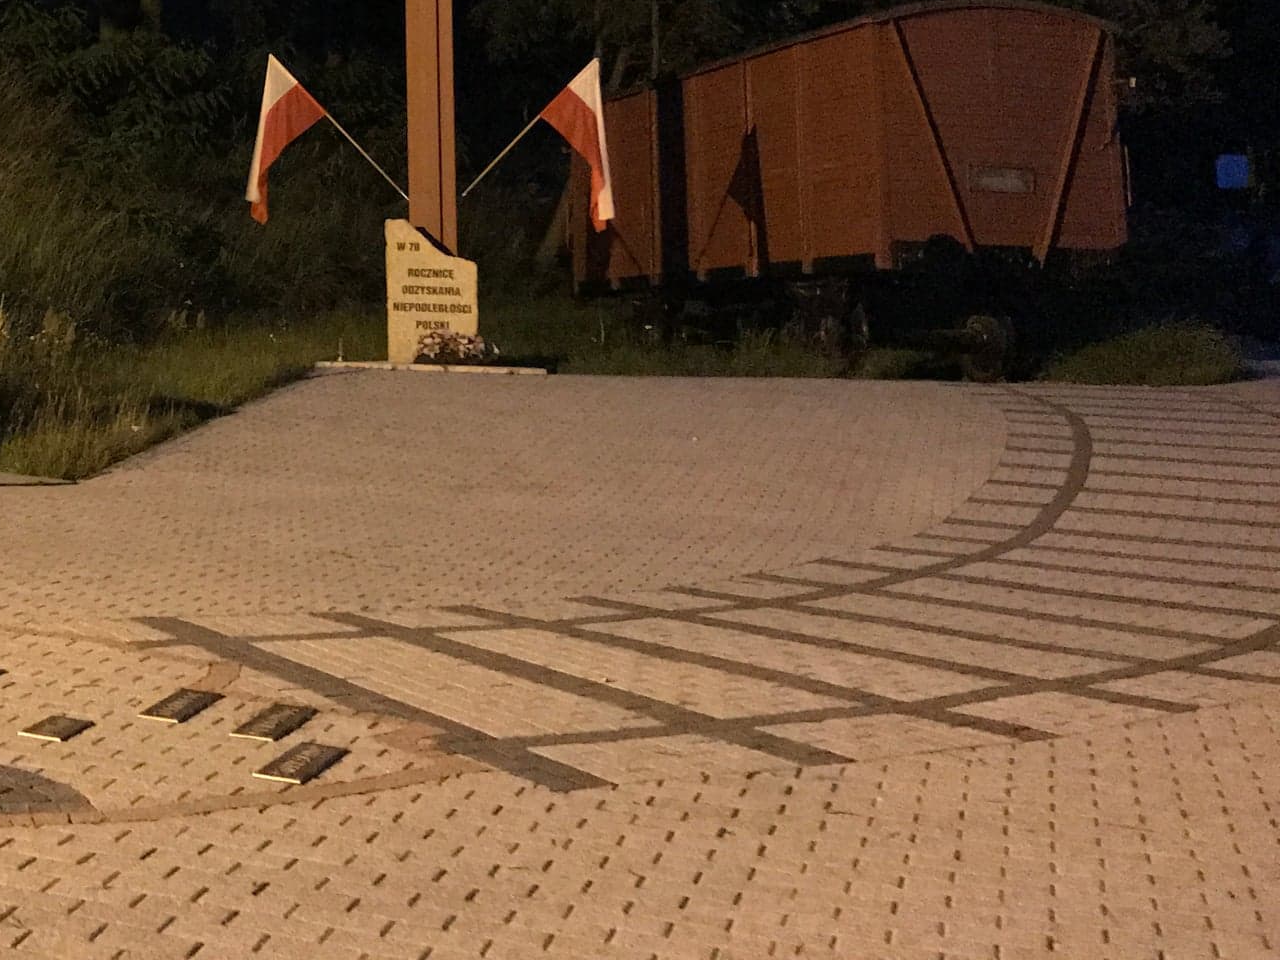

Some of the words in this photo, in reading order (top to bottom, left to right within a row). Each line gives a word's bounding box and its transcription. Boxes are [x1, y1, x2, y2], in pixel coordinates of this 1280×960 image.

[397, 242, 406, 251] W
[407, 268, 454, 280] ROCZNICĘ
[402, 285, 461, 296] ODZYSKANIA
[393, 302, 472, 314] NIEPODLEGŁOŚCI
[415, 320, 450, 330] POLSKI
